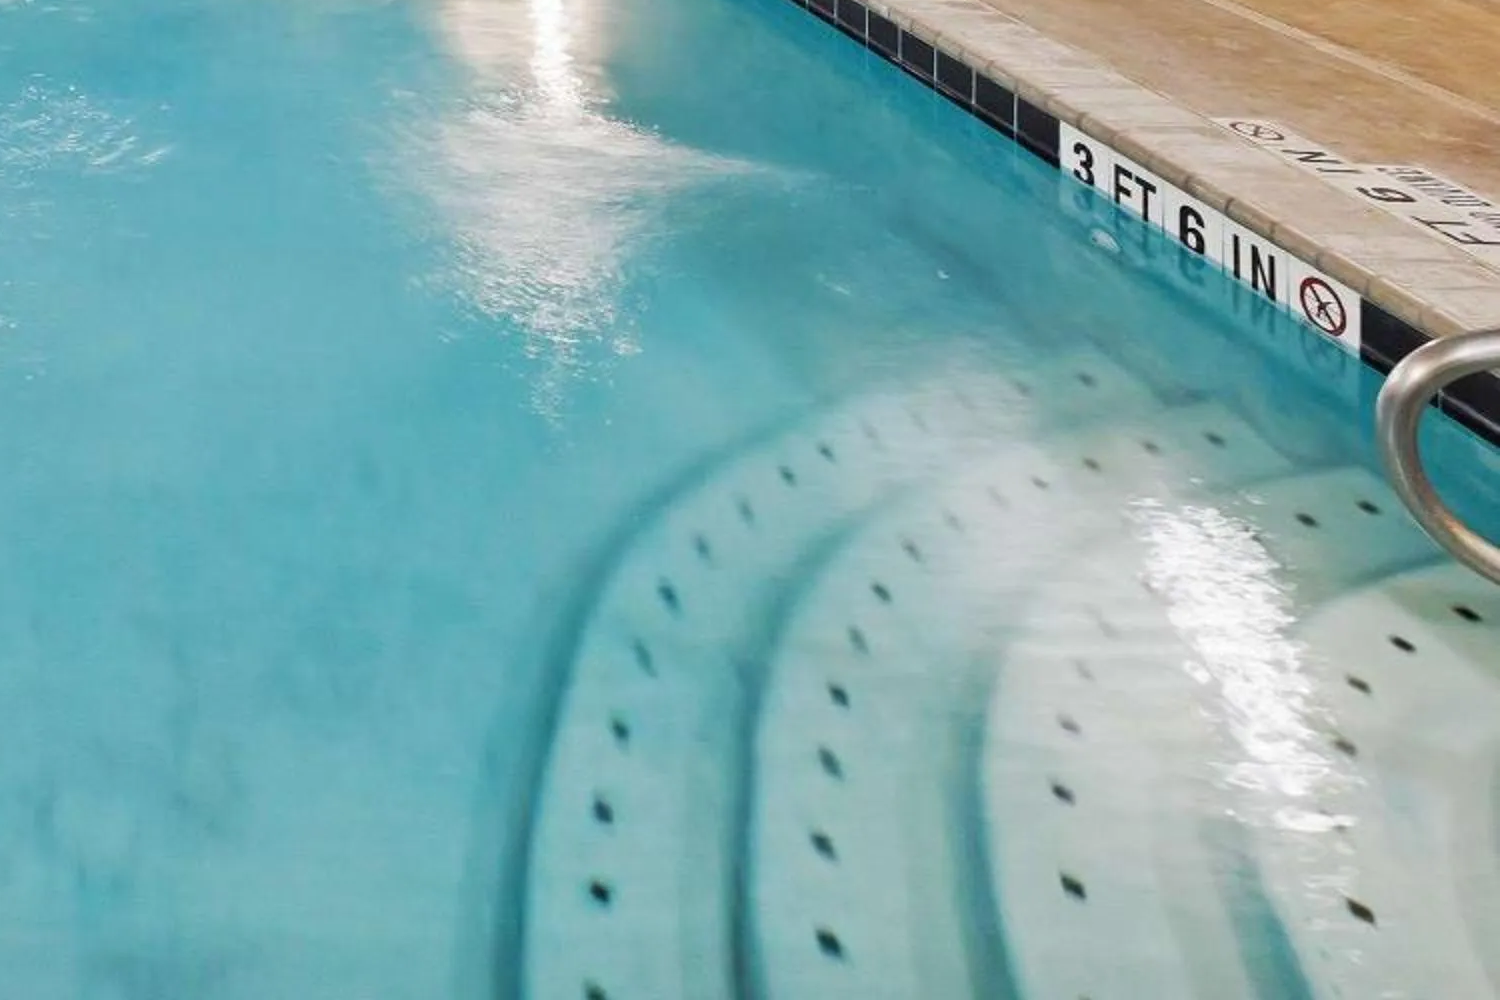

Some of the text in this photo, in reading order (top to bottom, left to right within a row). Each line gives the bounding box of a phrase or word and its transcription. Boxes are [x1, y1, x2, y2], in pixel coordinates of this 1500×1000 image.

[1071, 141, 1277, 302] 3 FT 6 IN
